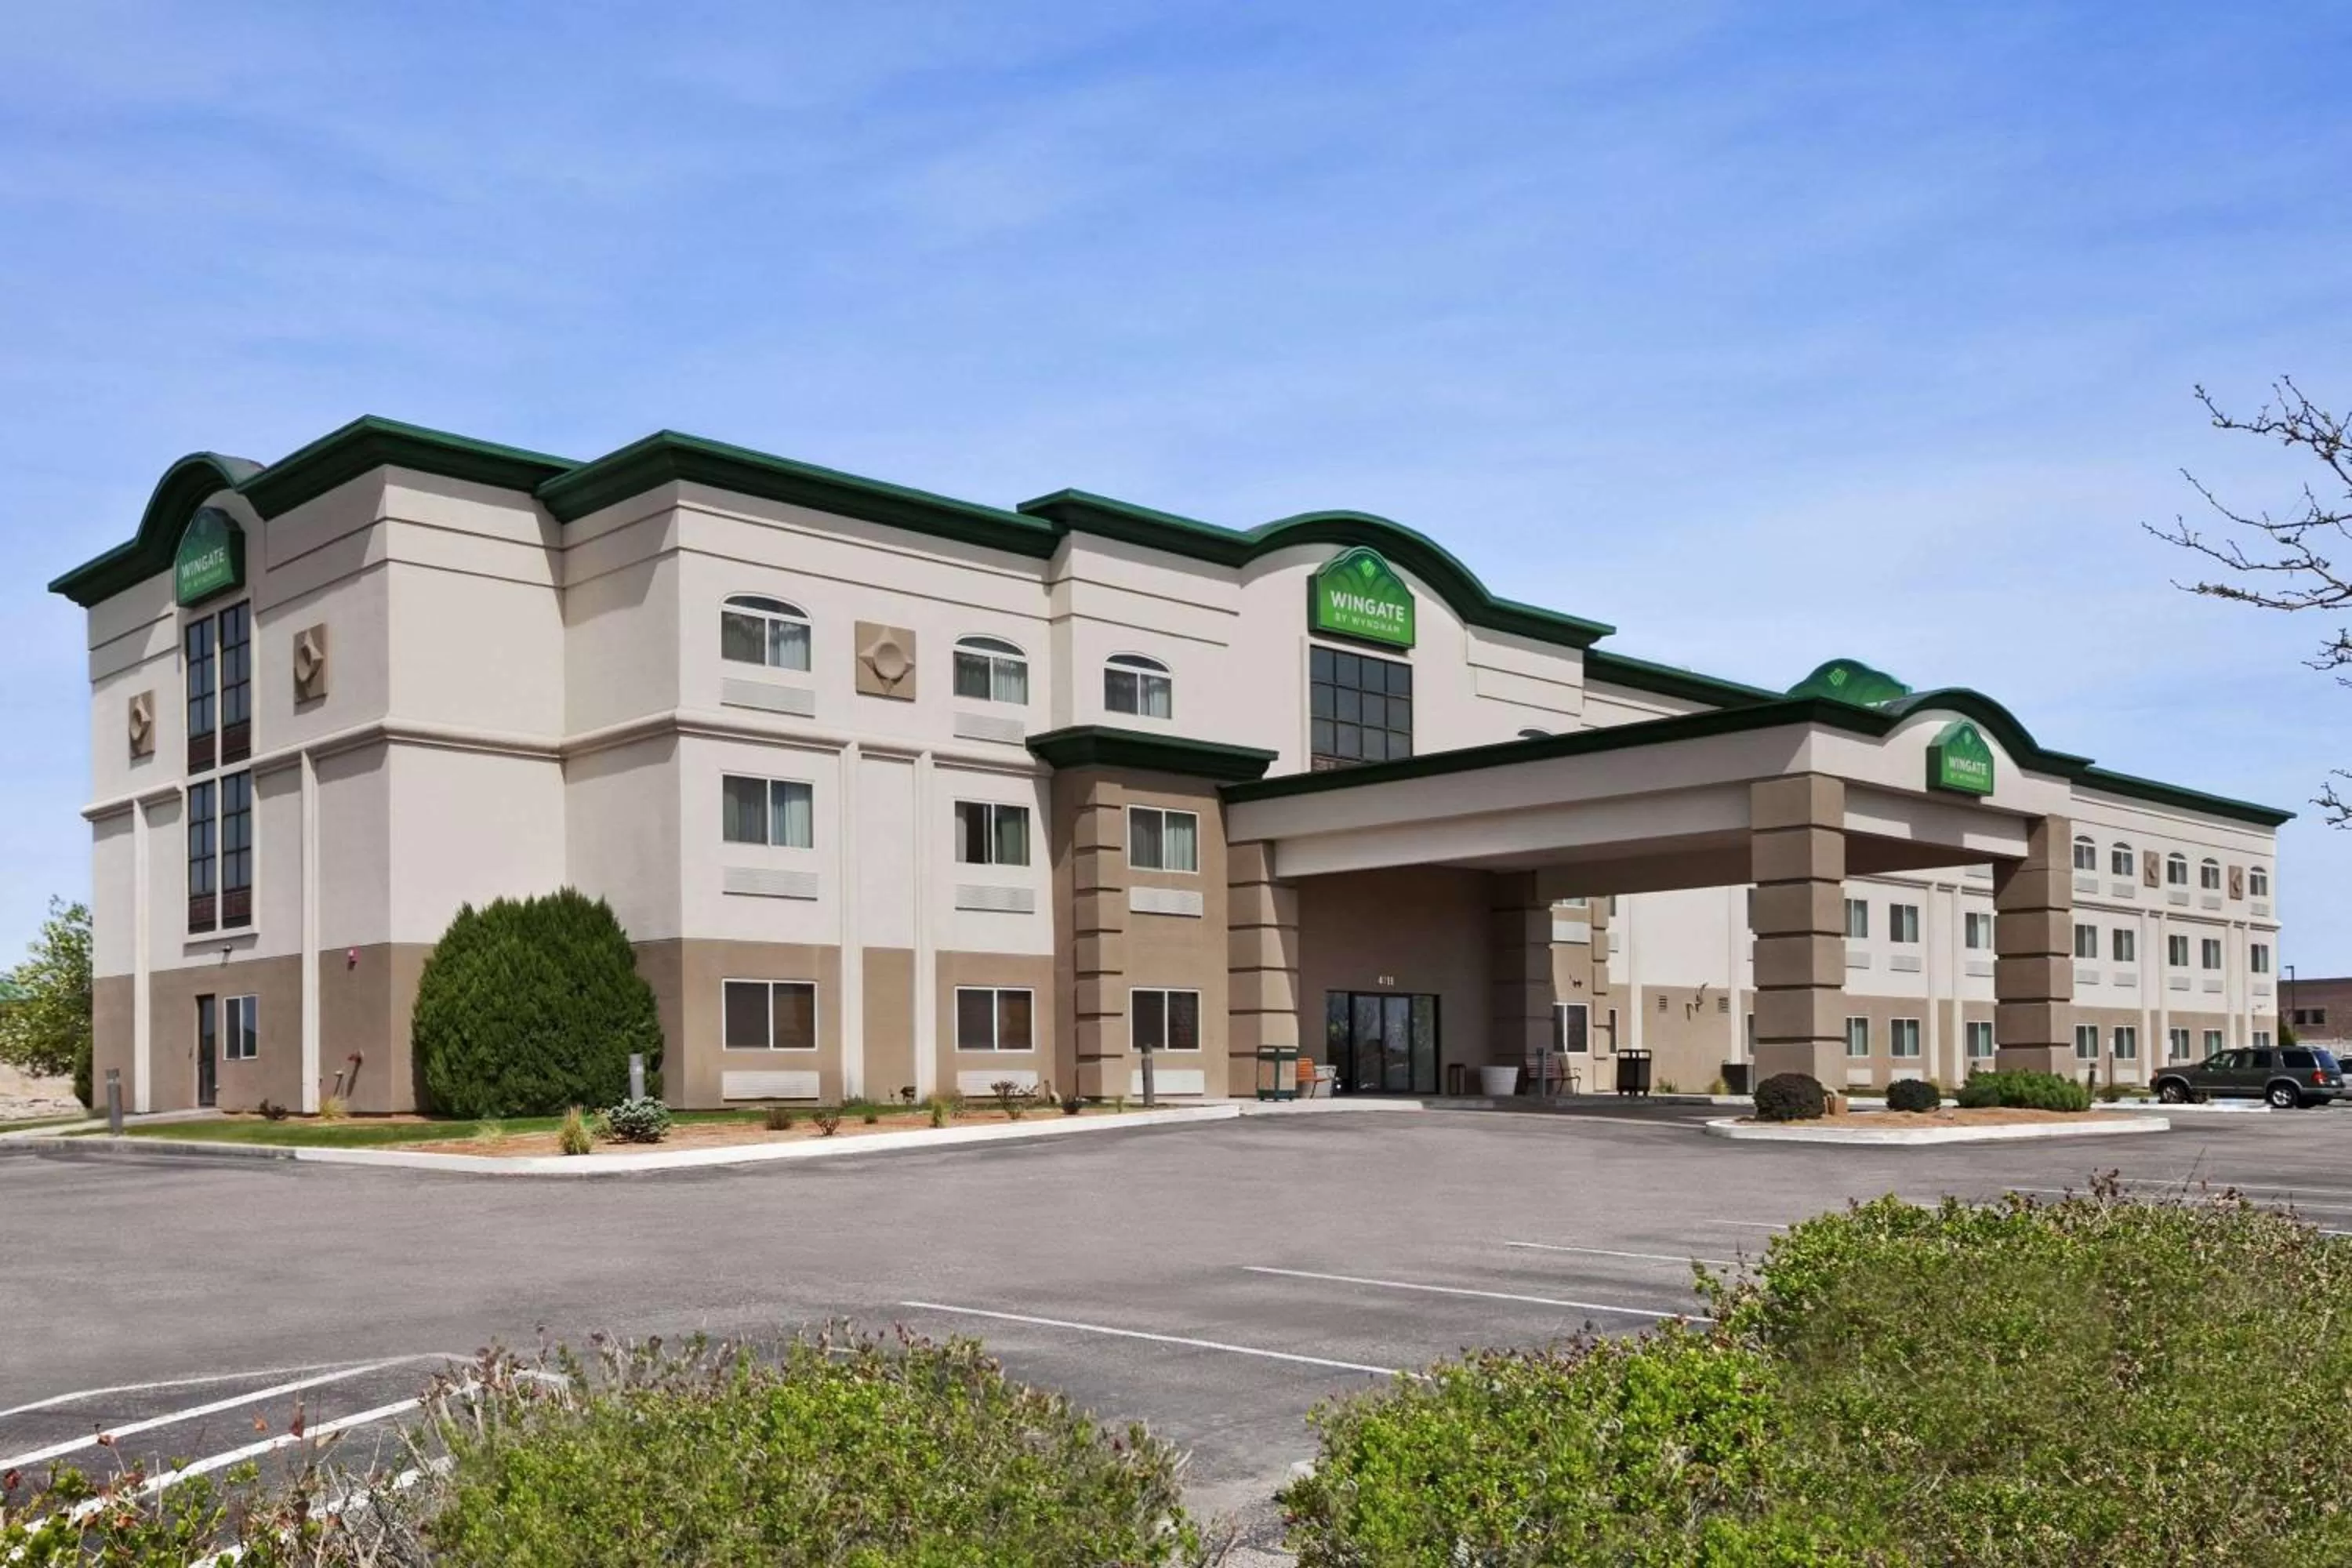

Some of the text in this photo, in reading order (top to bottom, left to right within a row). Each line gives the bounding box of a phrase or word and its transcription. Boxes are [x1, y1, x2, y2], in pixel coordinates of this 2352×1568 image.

[181, 546, 224, 579] WINGATE
[1330, 590, 1405, 622] WINGATE
[1334, 612, 1399, 633] BY WYNDHAM
[1948, 755, 1987, 775] WINGATE
